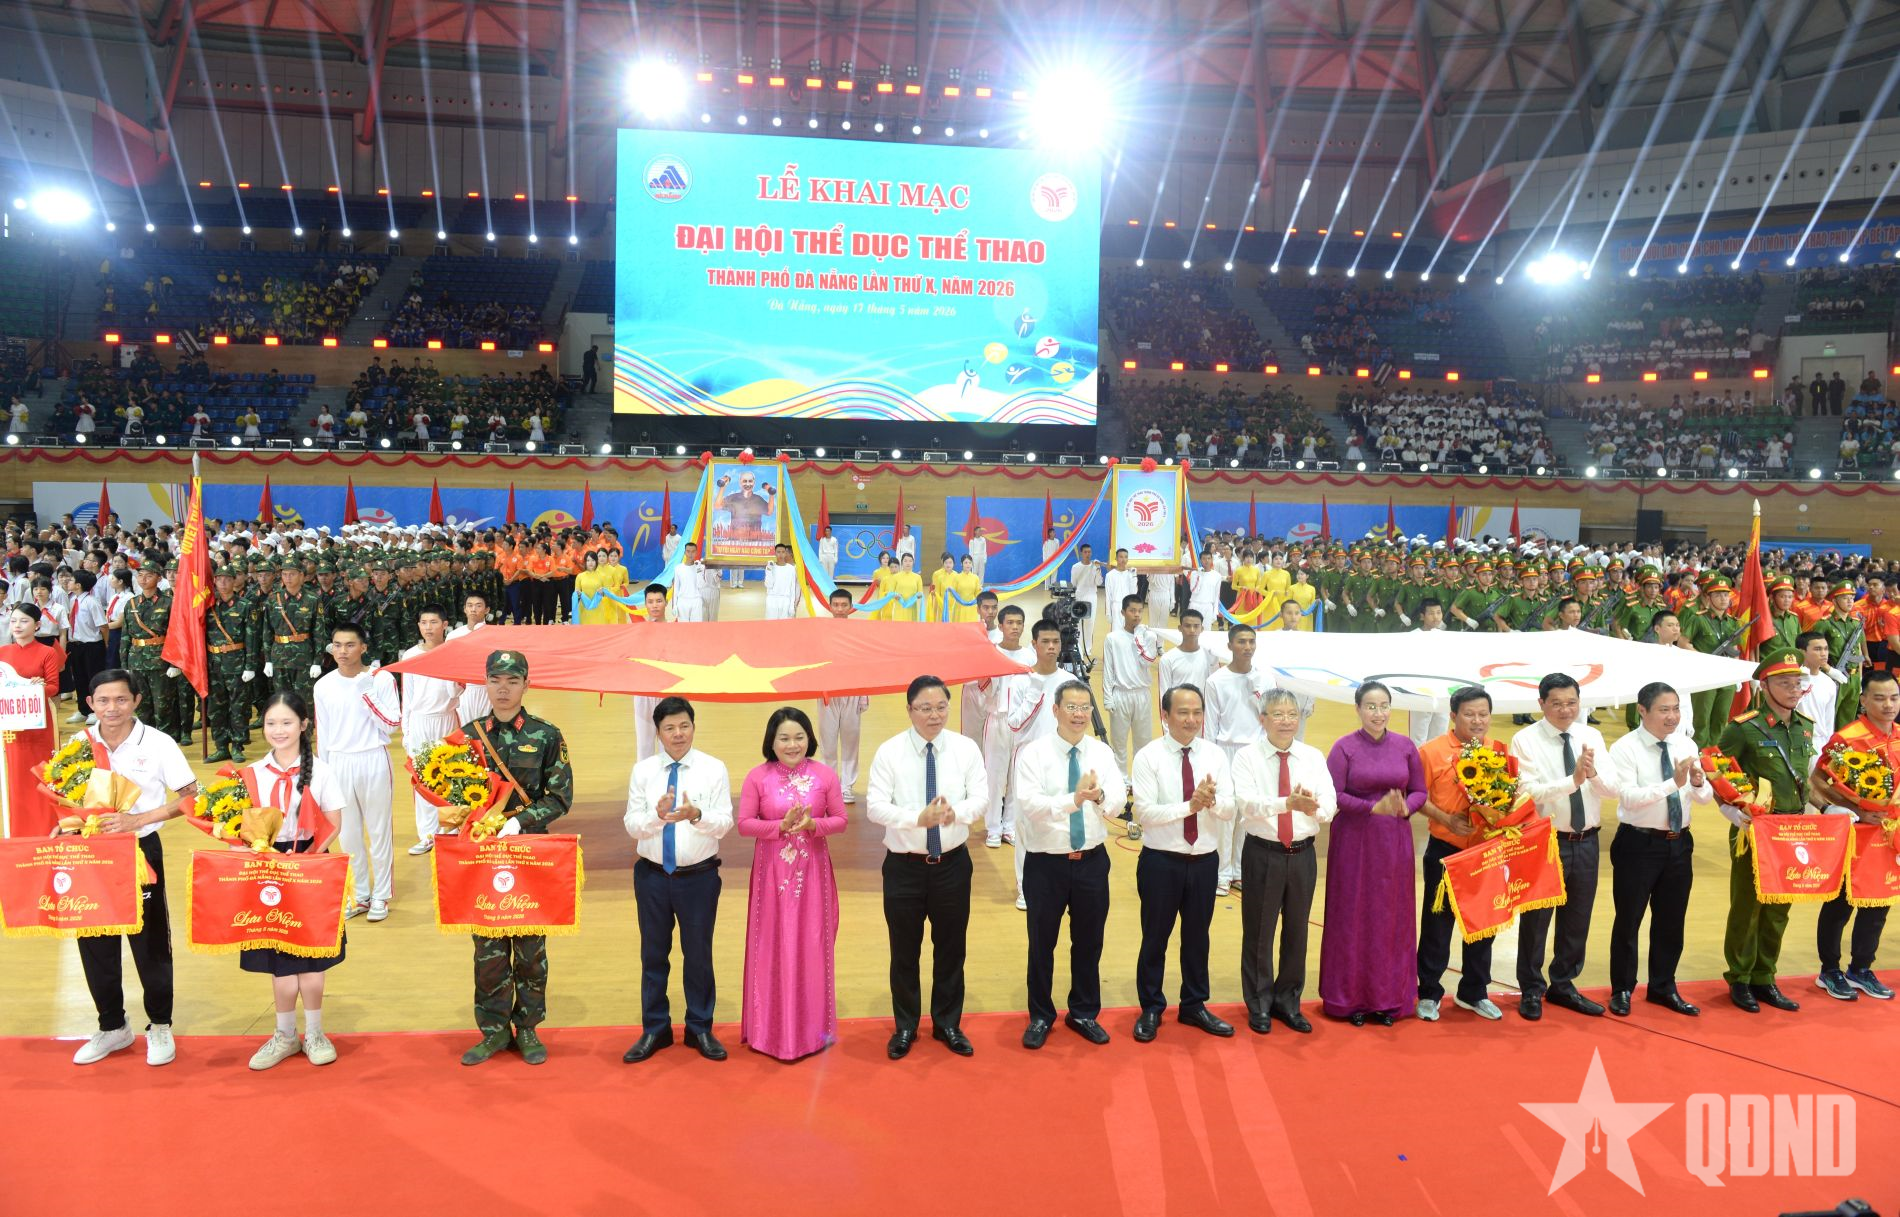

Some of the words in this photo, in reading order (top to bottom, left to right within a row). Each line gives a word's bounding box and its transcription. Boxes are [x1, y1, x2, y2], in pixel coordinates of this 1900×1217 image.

[758, 164, 800, 200] LỄ
[809, 179, 891, 205] KHAI
[899, 183, 969, 214] MẠC
[676, 225, 724, 253] ĐẠI
[734, 225, 783, 256] HỘI
[792, 224, 843, 255] THỂ
[852, 233, 909, 262] DỤC
[918, 230, 969, 260] THỂ
[975, 239, 1045, 264] THAO
[707, 267, 755, 286] THÀNH
[761, 266, 790, 288] PHỐ
[795, 271, 815, 289] ĐÀ
[819, 269, 858, 290] NẴNG
[863, 270, 888, 292] LẦN
[893, 275, 922, 293] THỨ
[925, 278, 937, 296] X,
[942, 277, 973, 295] NĂM
[978, 281, 1015, 296] 2026
[16, 694, 27, 718] BỘ
[28, 694, 42, 718] ĐỘI
[36, 846, 54, 854] BAN
[55, 842, 64, 853] TỔ
[66, 844, 90, 853] CHỨC
[480, 844, 496, 852] BAN
[509, 844, 531, 853] CHỨC
[244, 861, 262, 869] BAN
[277, 861, 300, 870] CHỨC
[57, 895, 100, 914] Niệm
[474, 893, 497, 911] Lưu
[499, 893, 540, 912] Niệm
[230, 910, 262, 927] Lưu
[265, 908, 304, 928] Niệm
